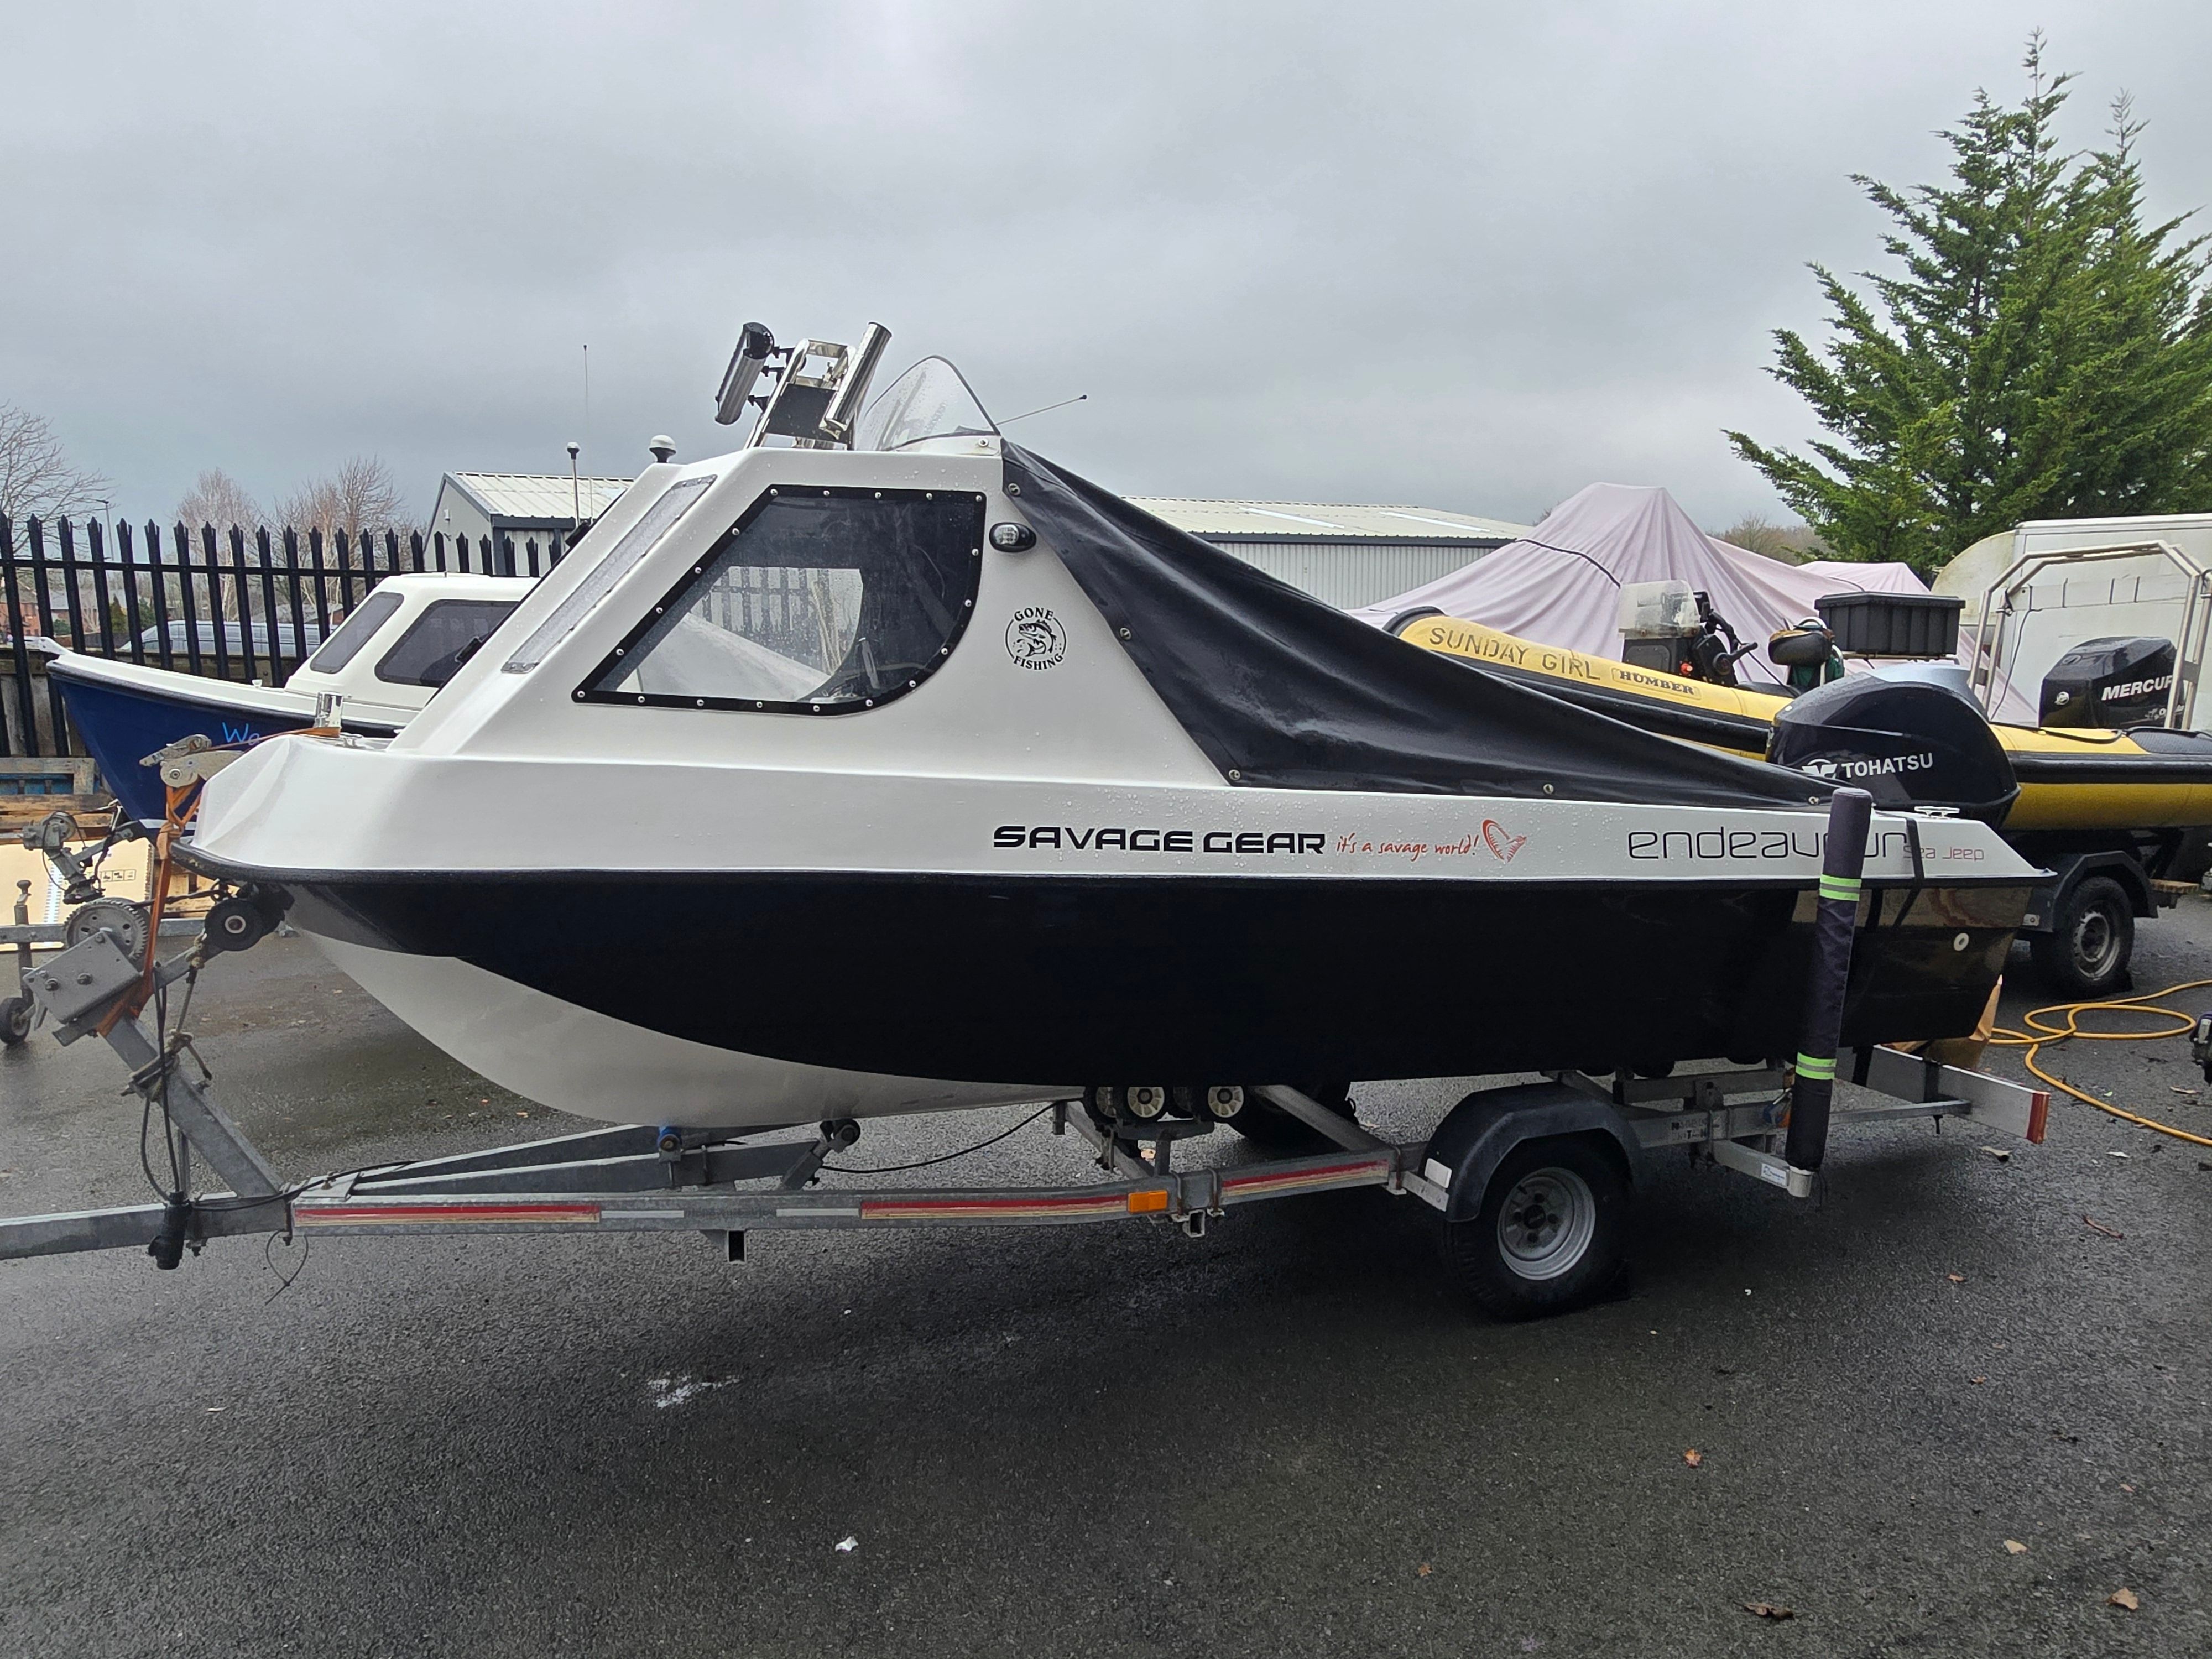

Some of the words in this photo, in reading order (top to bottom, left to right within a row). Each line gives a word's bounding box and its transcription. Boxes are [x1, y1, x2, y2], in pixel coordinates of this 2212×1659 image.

[1014, 607, 1053, 621] GONE
[1014, 653, 1063, 670] FISHING
[1429, 627, 1529, 665] SUNDAY
[1542, 653, 1601, 681] GIRL
[1619, 670, 1694, 695] HUMBER
[2101, 675, 2173, 701] MERCUR
[1841, 752, 1933, 779] TOHATSU
[993, 826, 1193, 853] SAVAGE
[1203, 832, 1326, 854] GEAR
[1336, 833, 1357, 853] it's
[1361, 842, 1373, 853] a
[1378, 841, 1428, 862] savage
[1434, 834, 1479, 856] world!
[1628, 826, 1907, 859] endeavur
[1942, 846, 1985, 862] Jeep
